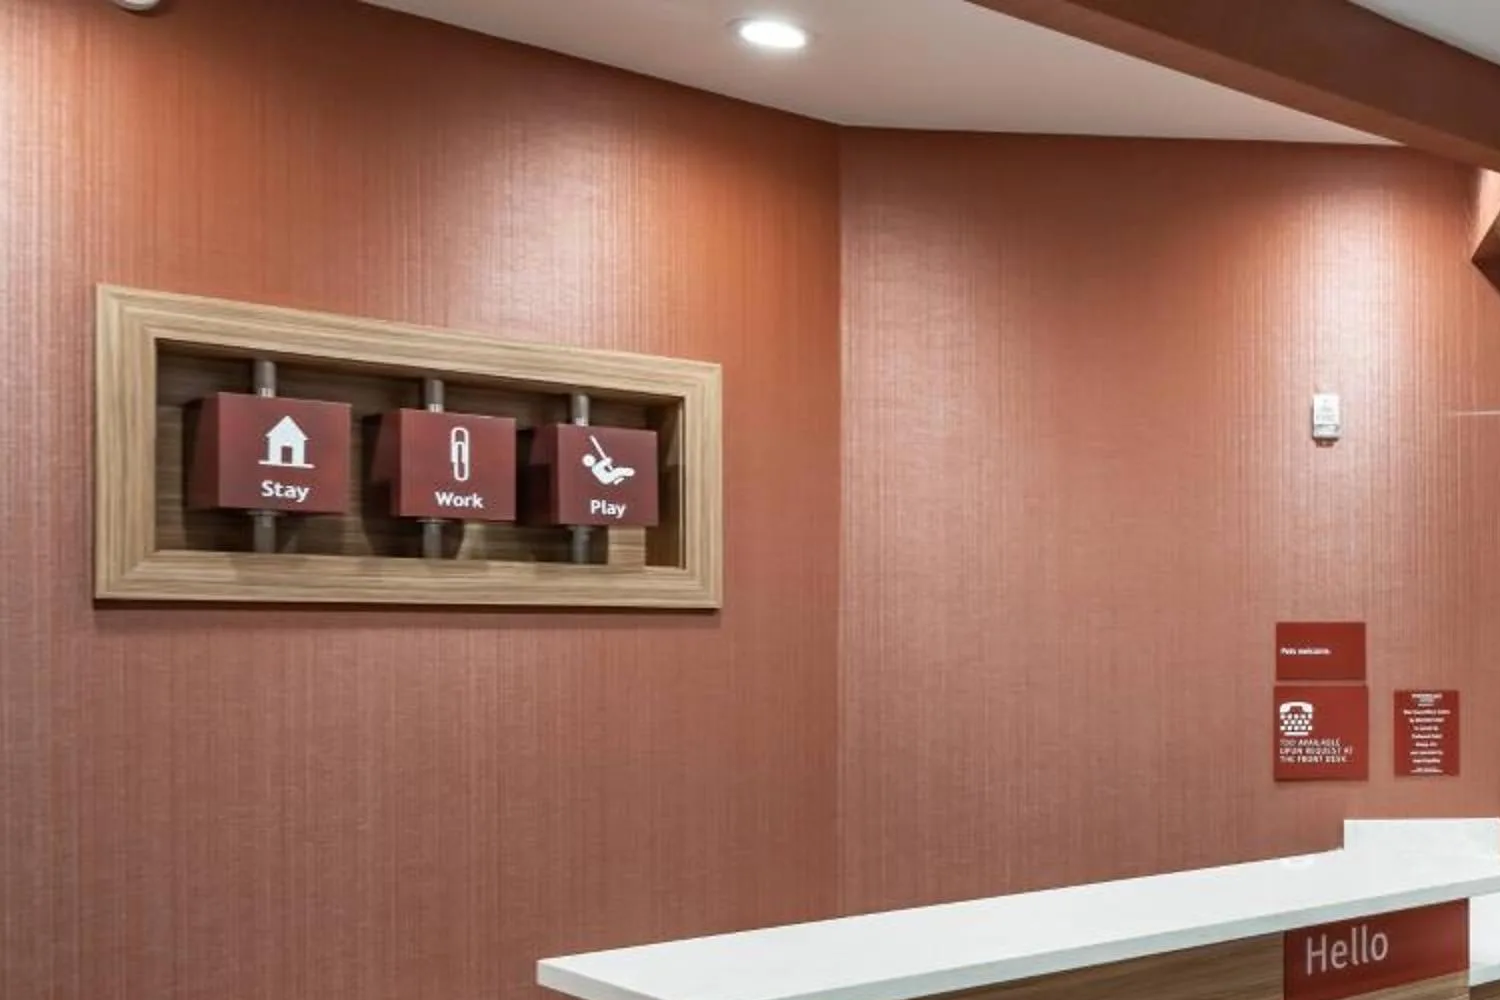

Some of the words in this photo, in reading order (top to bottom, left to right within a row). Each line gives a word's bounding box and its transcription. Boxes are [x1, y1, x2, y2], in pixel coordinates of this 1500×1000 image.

[261, 480, 310, 503] Stay
[434, 491, 484, 509] Work
[590, 499, 626, 519] Play
[1306, 924, 1389, 976] Hello
